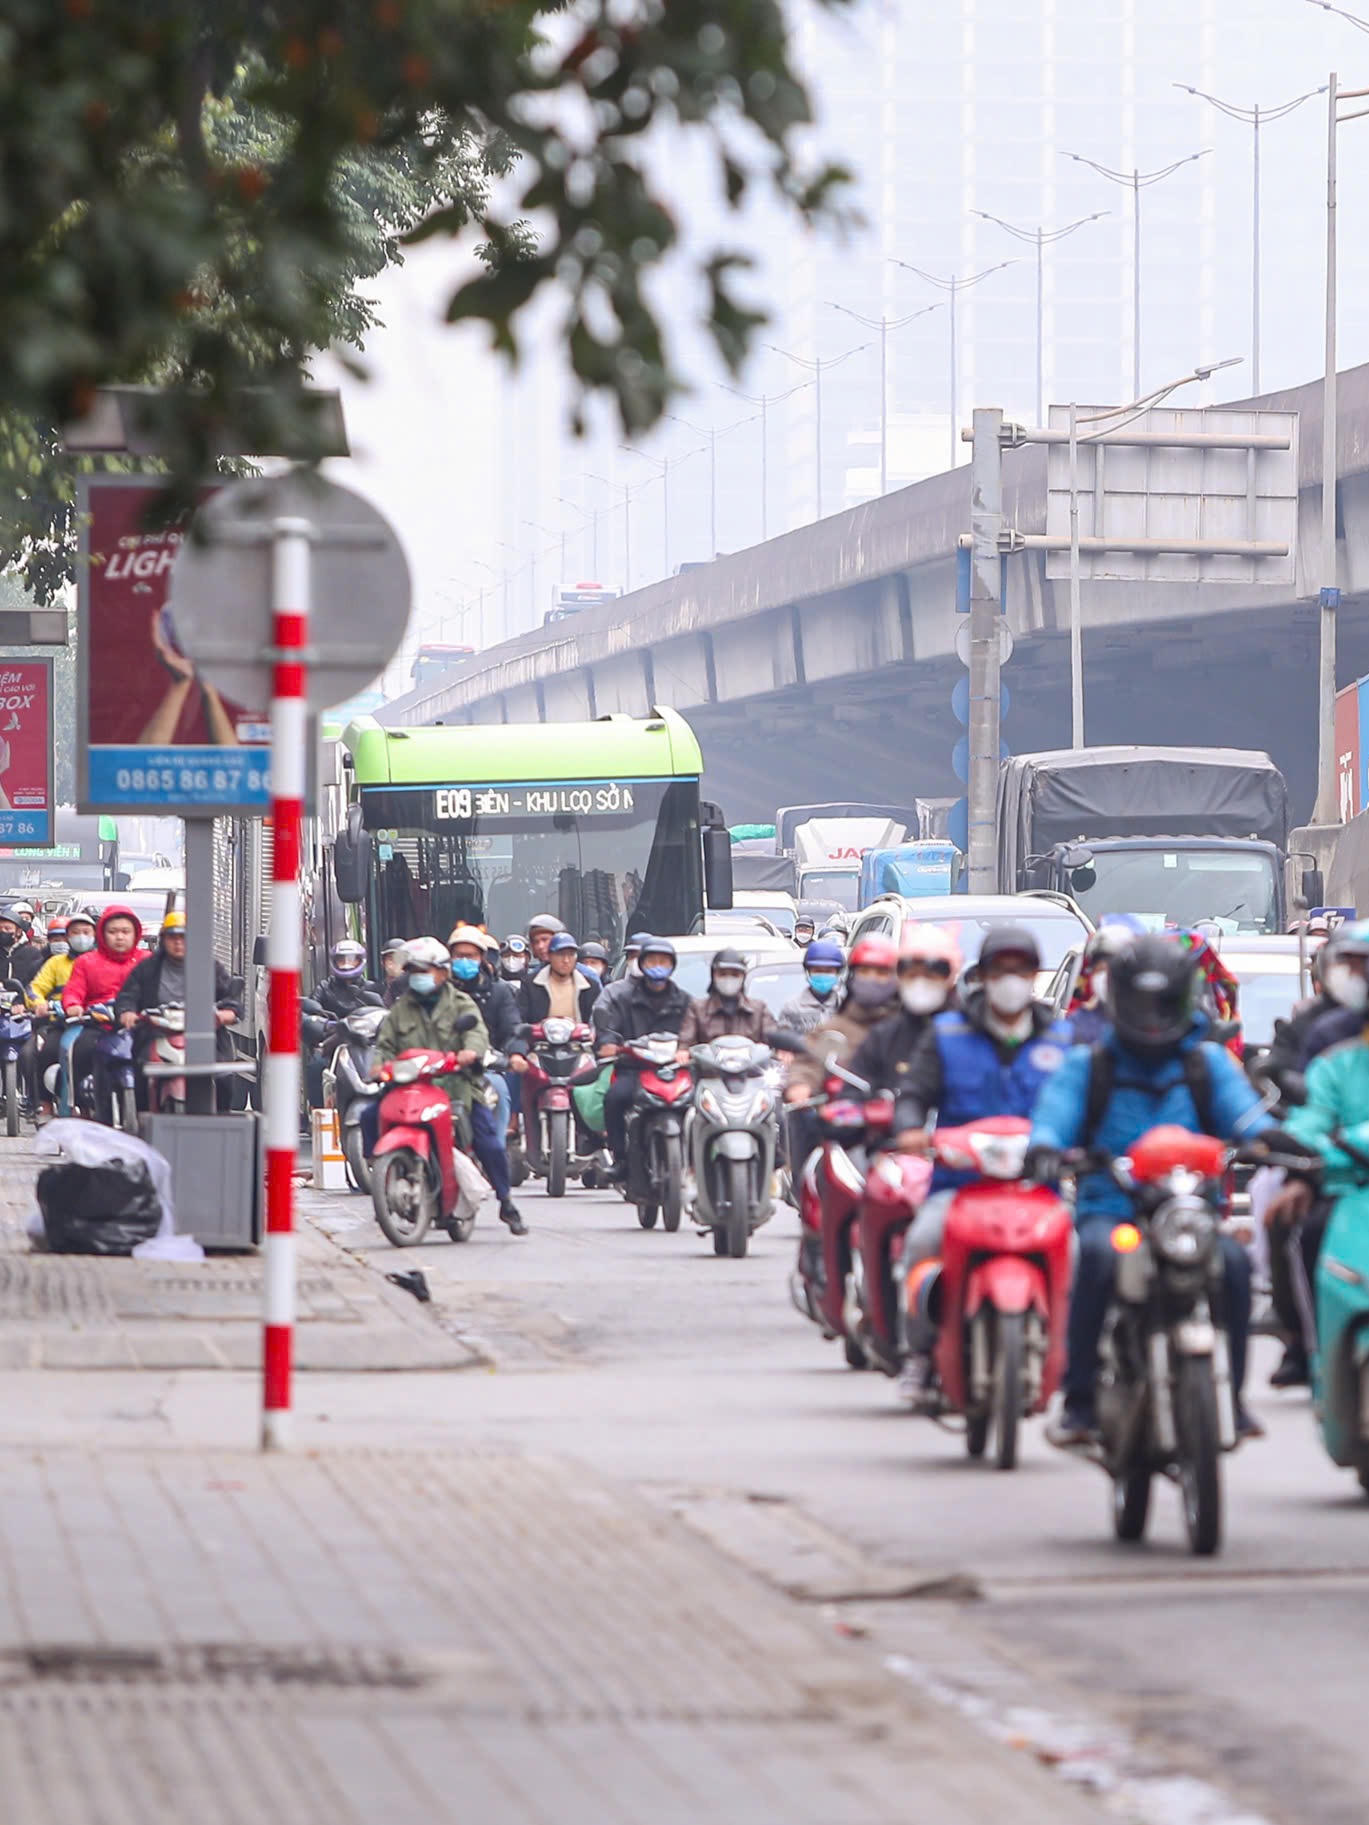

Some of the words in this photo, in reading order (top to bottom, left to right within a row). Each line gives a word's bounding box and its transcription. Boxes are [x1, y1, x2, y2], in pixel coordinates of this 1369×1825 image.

[104, 549, 175, 579] LIGH
[436, 789, 472, 819] E09
[526, 791, 558, 812] KHU
